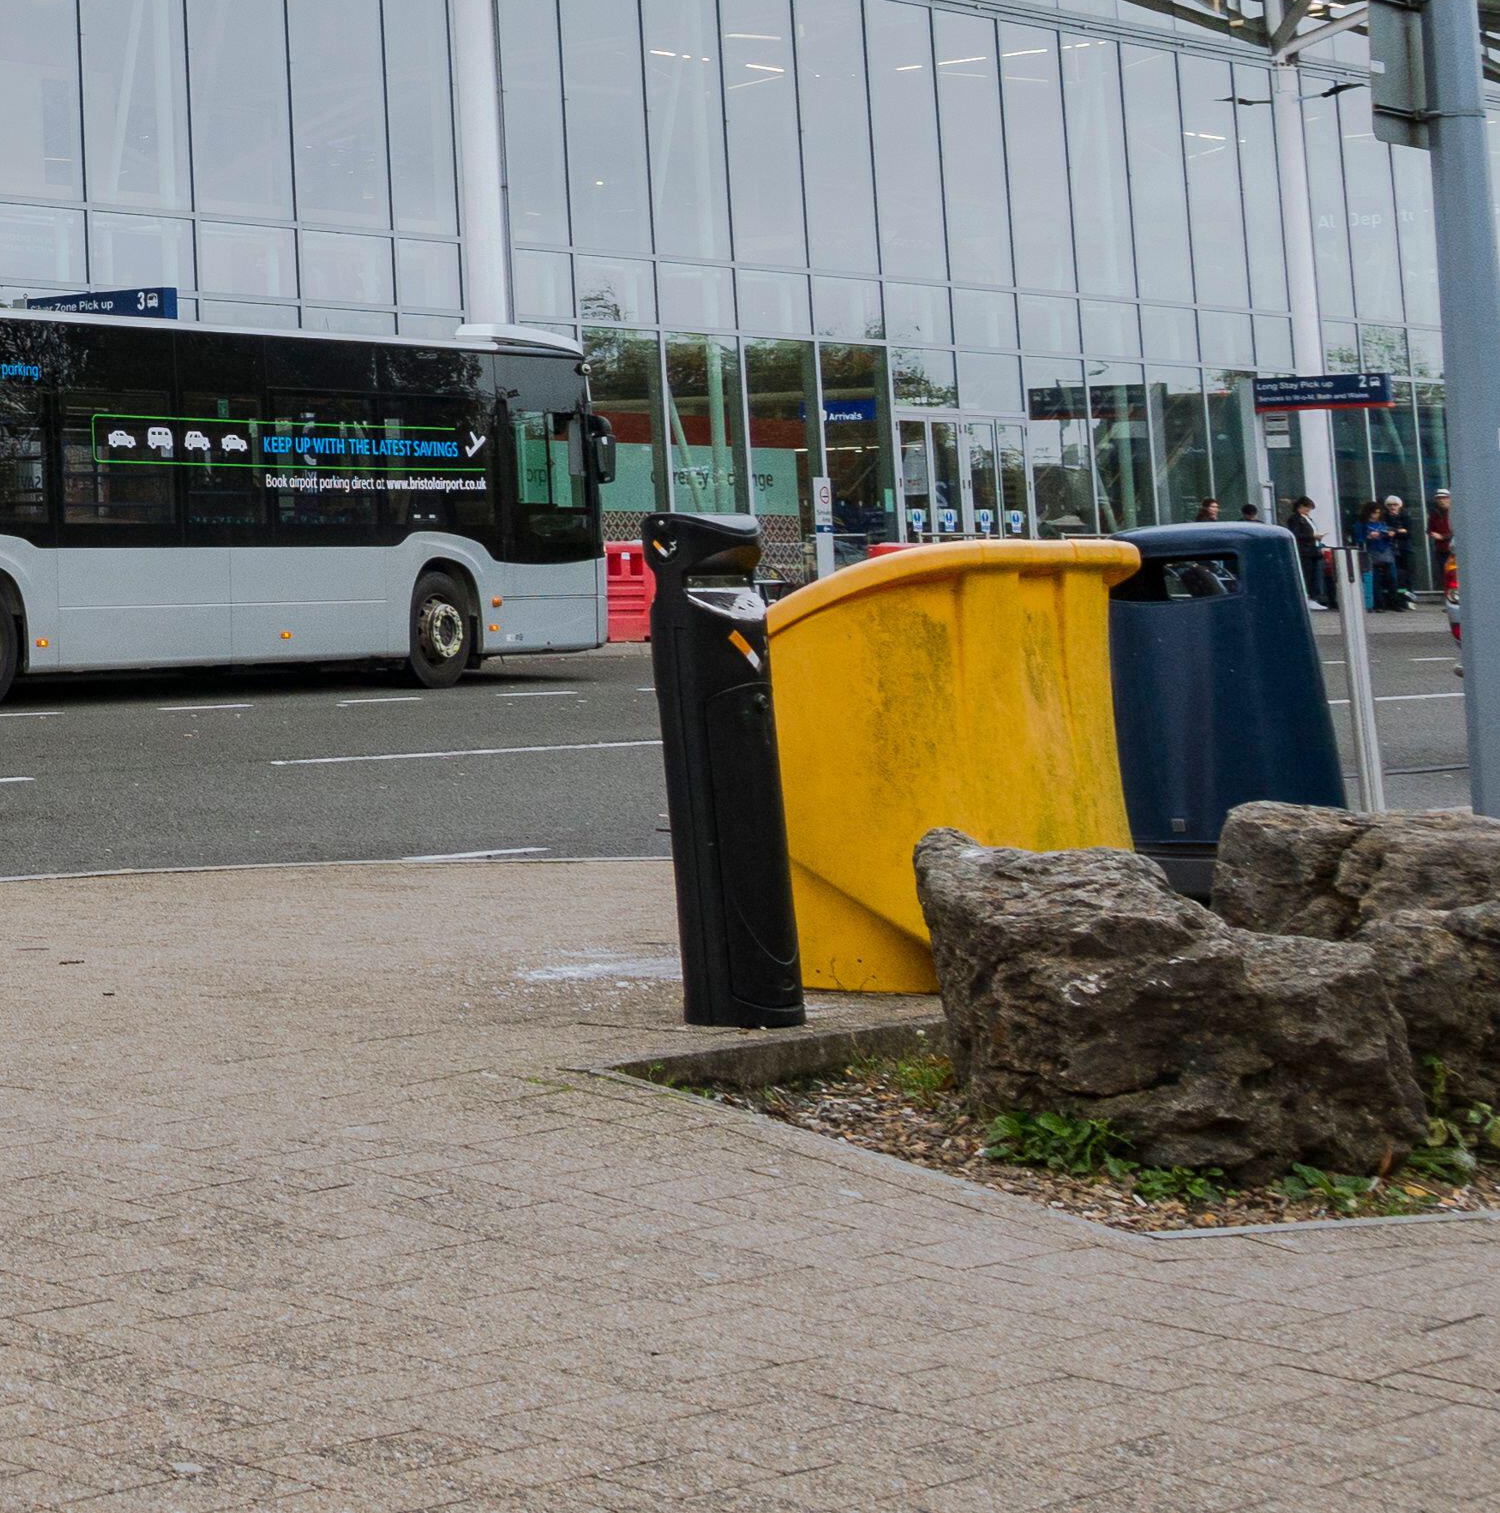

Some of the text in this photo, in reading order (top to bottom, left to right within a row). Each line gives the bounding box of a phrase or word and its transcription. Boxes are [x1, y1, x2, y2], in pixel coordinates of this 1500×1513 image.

[55, 303, 77, 312] Zone
[79, 300, 99, 311] Pick
[101, 300, 114, 310] up
[137, 291, 145, 311] 3
[1, 362, 39, 380] parking
[1256, 382, 1278, 391] Long
[1279, 381, 1299, 390] Stay
[1301, 380, 1319, 388] Pick
[1358, 376, 1367, 388] 2
[829, 411, 863, 421] Arrivals
[263, 437, 458, 457] KEEP UP WITH THE LATEST SAVINGS
[265, 474, 487, 493] Book airport parking direct at www.bristolairport.co.uk
